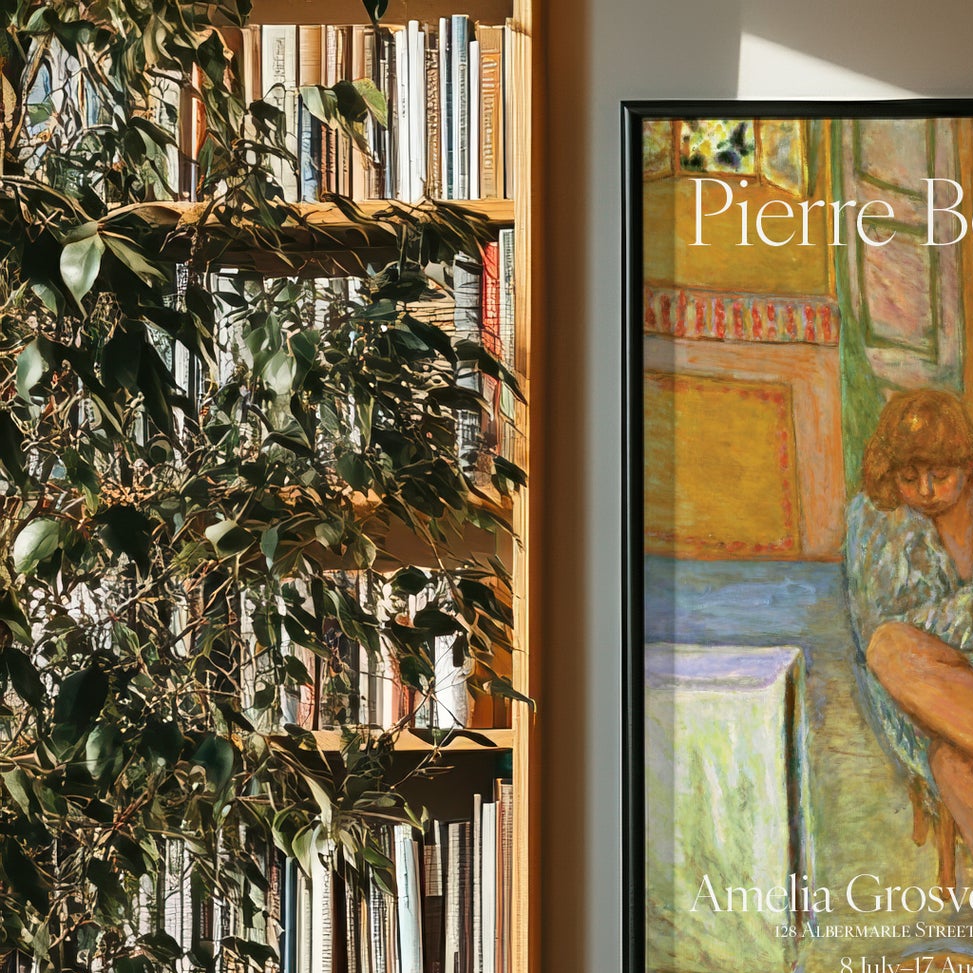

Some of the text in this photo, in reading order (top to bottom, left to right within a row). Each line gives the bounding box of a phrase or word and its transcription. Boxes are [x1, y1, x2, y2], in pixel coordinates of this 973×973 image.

[688, 178, 897, 247] Pierre
[689, 873, 834, 913] Amelia
[775, 926, 798, 938] 128
